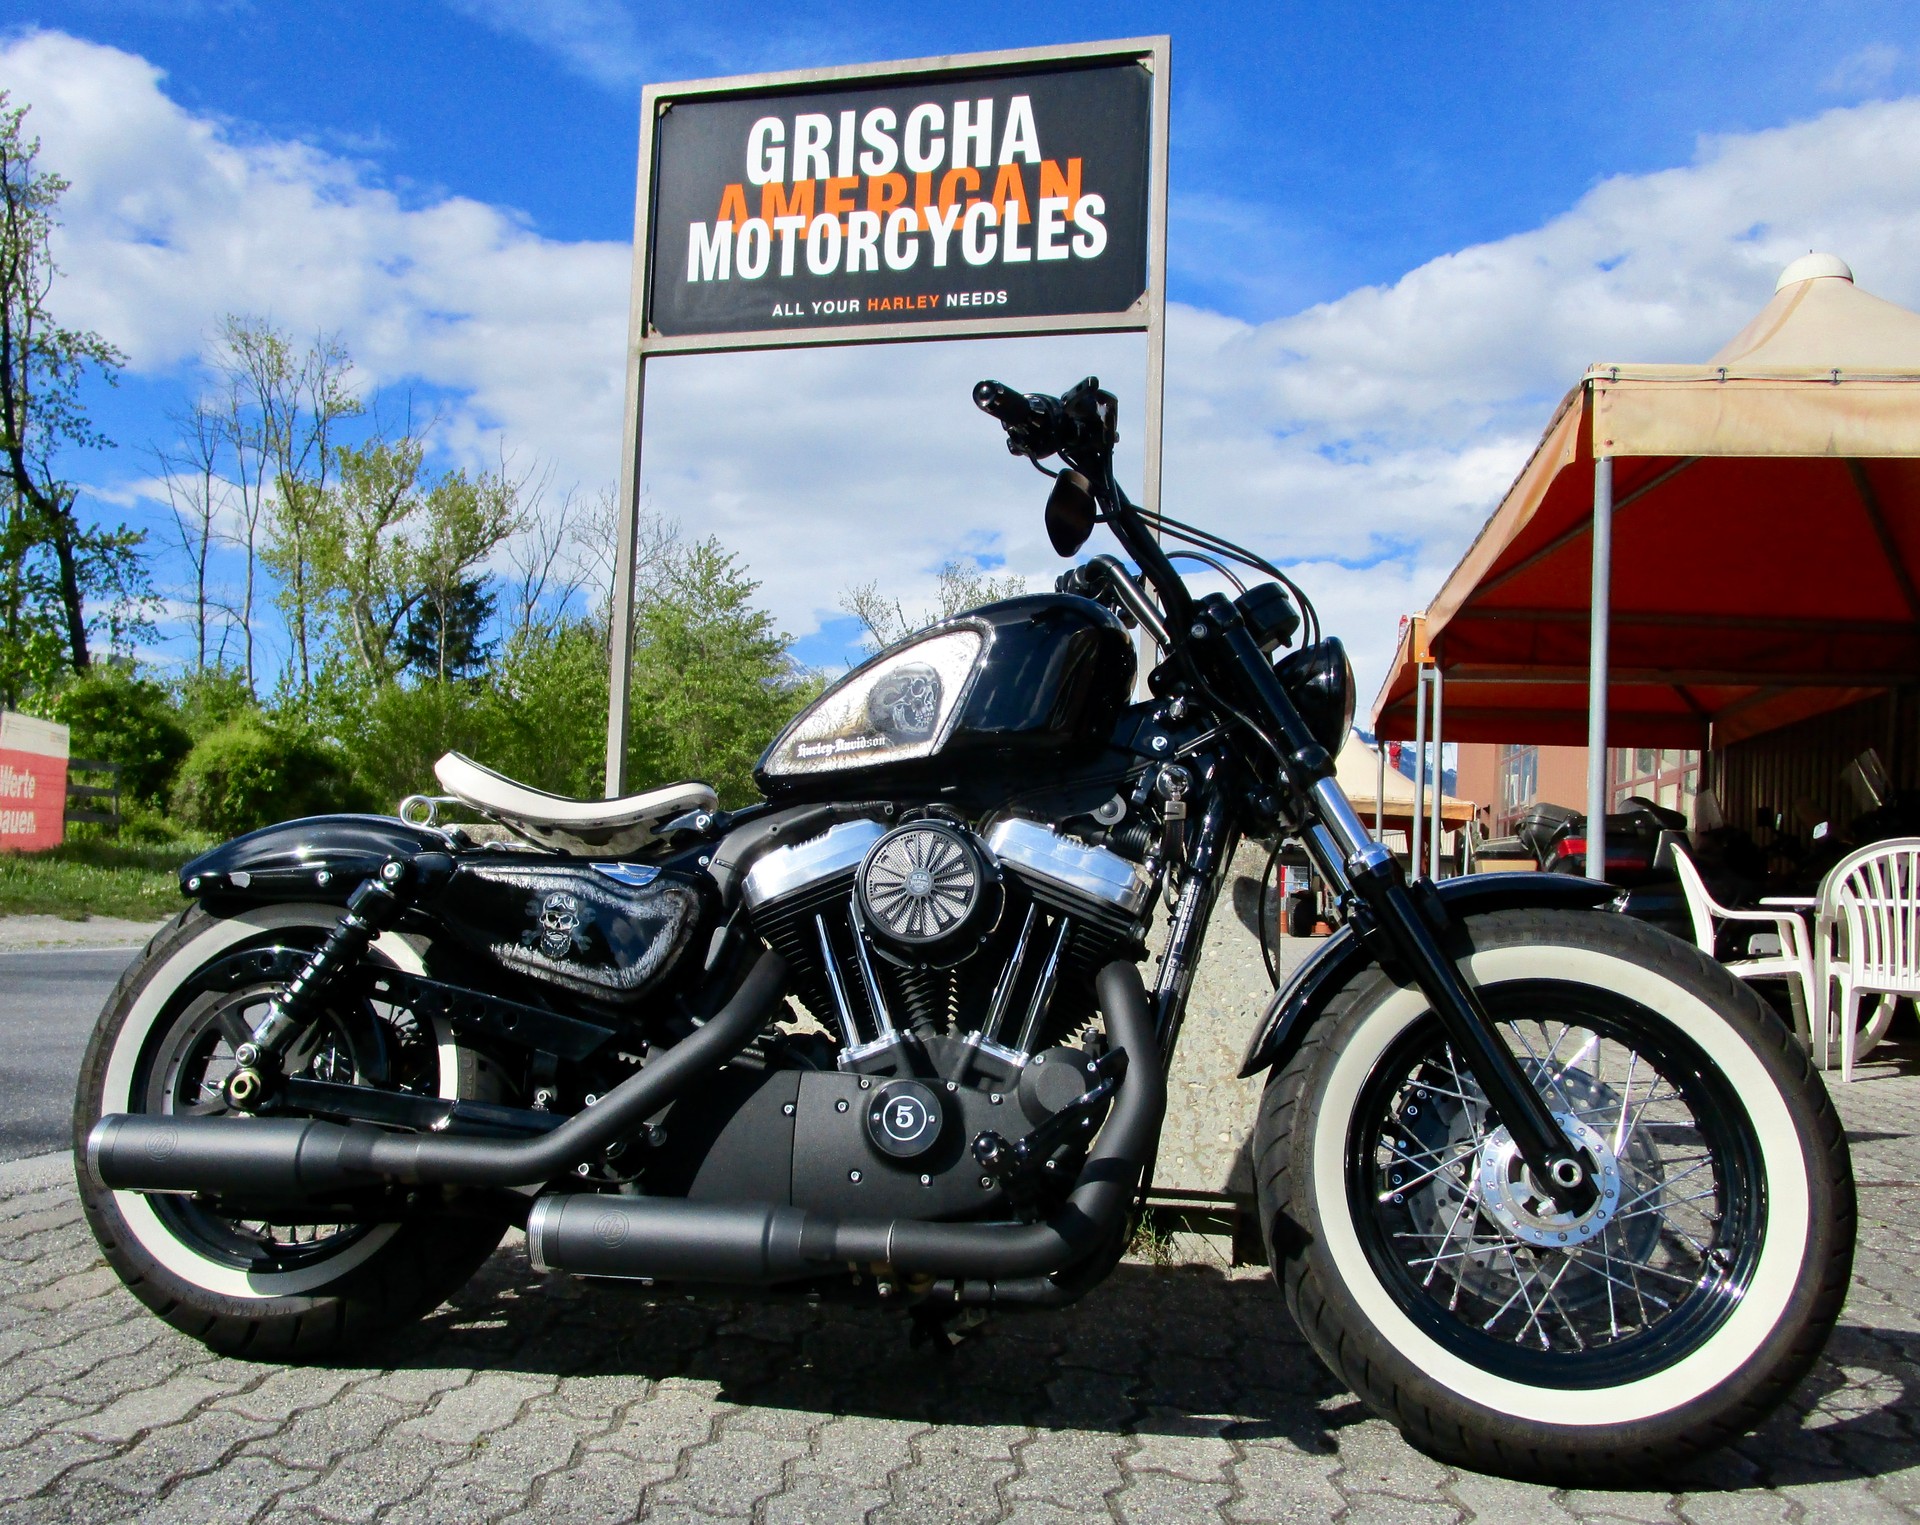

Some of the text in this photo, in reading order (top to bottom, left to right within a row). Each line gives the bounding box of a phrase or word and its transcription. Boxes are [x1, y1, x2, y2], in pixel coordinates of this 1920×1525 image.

[746, 95, 1041, 186] GRISCHA
[687, 193, 1108, 283] MOTORCYCLES
[717, 157, 1084, 242] AMERICAN
[772, 291, 1008, 316] ALL YOUR HARLEY NEEDS
[895, 1104, 914, 1128] 5
